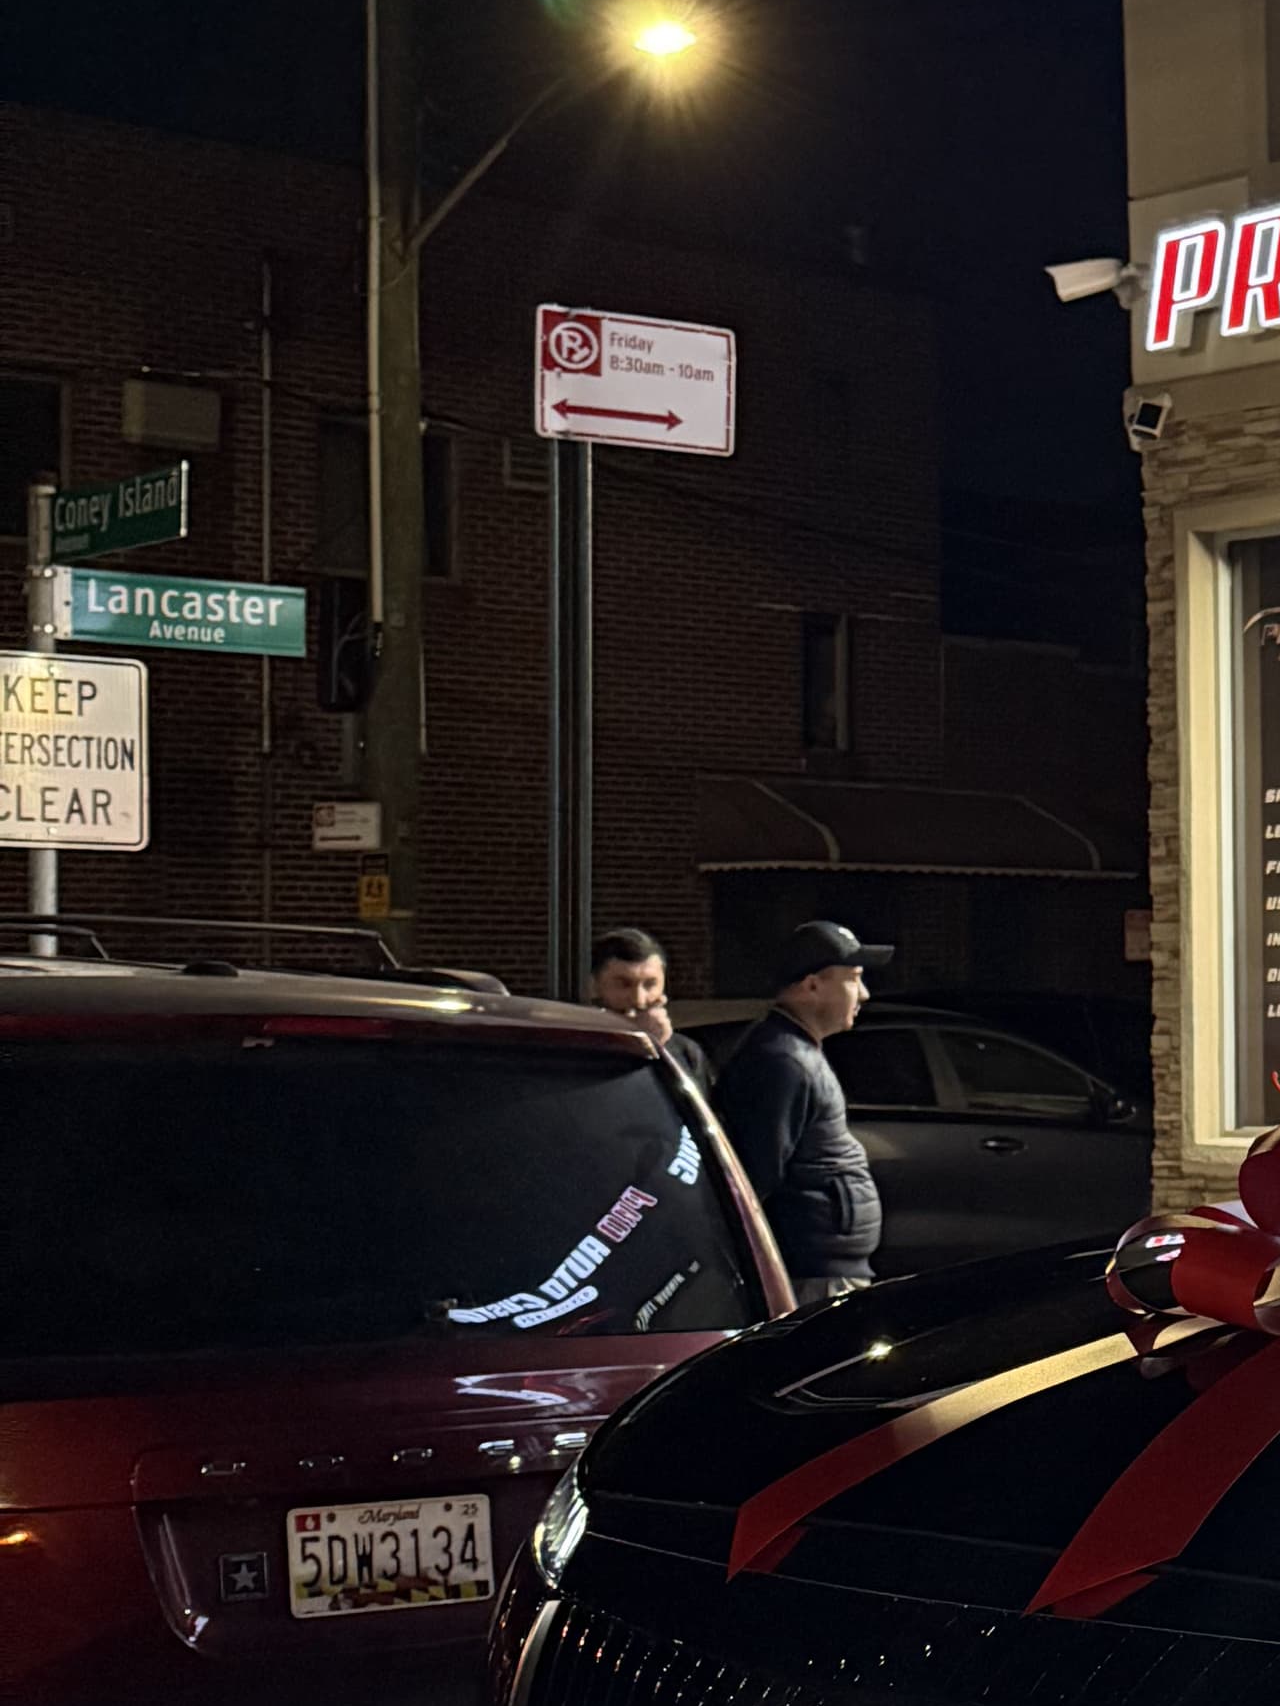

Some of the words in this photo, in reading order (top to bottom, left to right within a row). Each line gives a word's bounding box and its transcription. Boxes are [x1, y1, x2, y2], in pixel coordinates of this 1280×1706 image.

[609, 331, 654, 355] Friday
[609, 355, 665, 377] 8:30am
[678, 364, 714, 382] 10am
[54, 493, 112, 533] Coney
[118, 475, 178, 518] Island
[87, 578, 284, 627] Lancaster
[149, 619, 226, 644] Avenue
[3, 674, 98, 717] KEEP
[358, 1504, 422, 1526] Maryland
[463, 1503, 479, 1517] 25
[300, 1523, 479, 1588] 5DW3134
